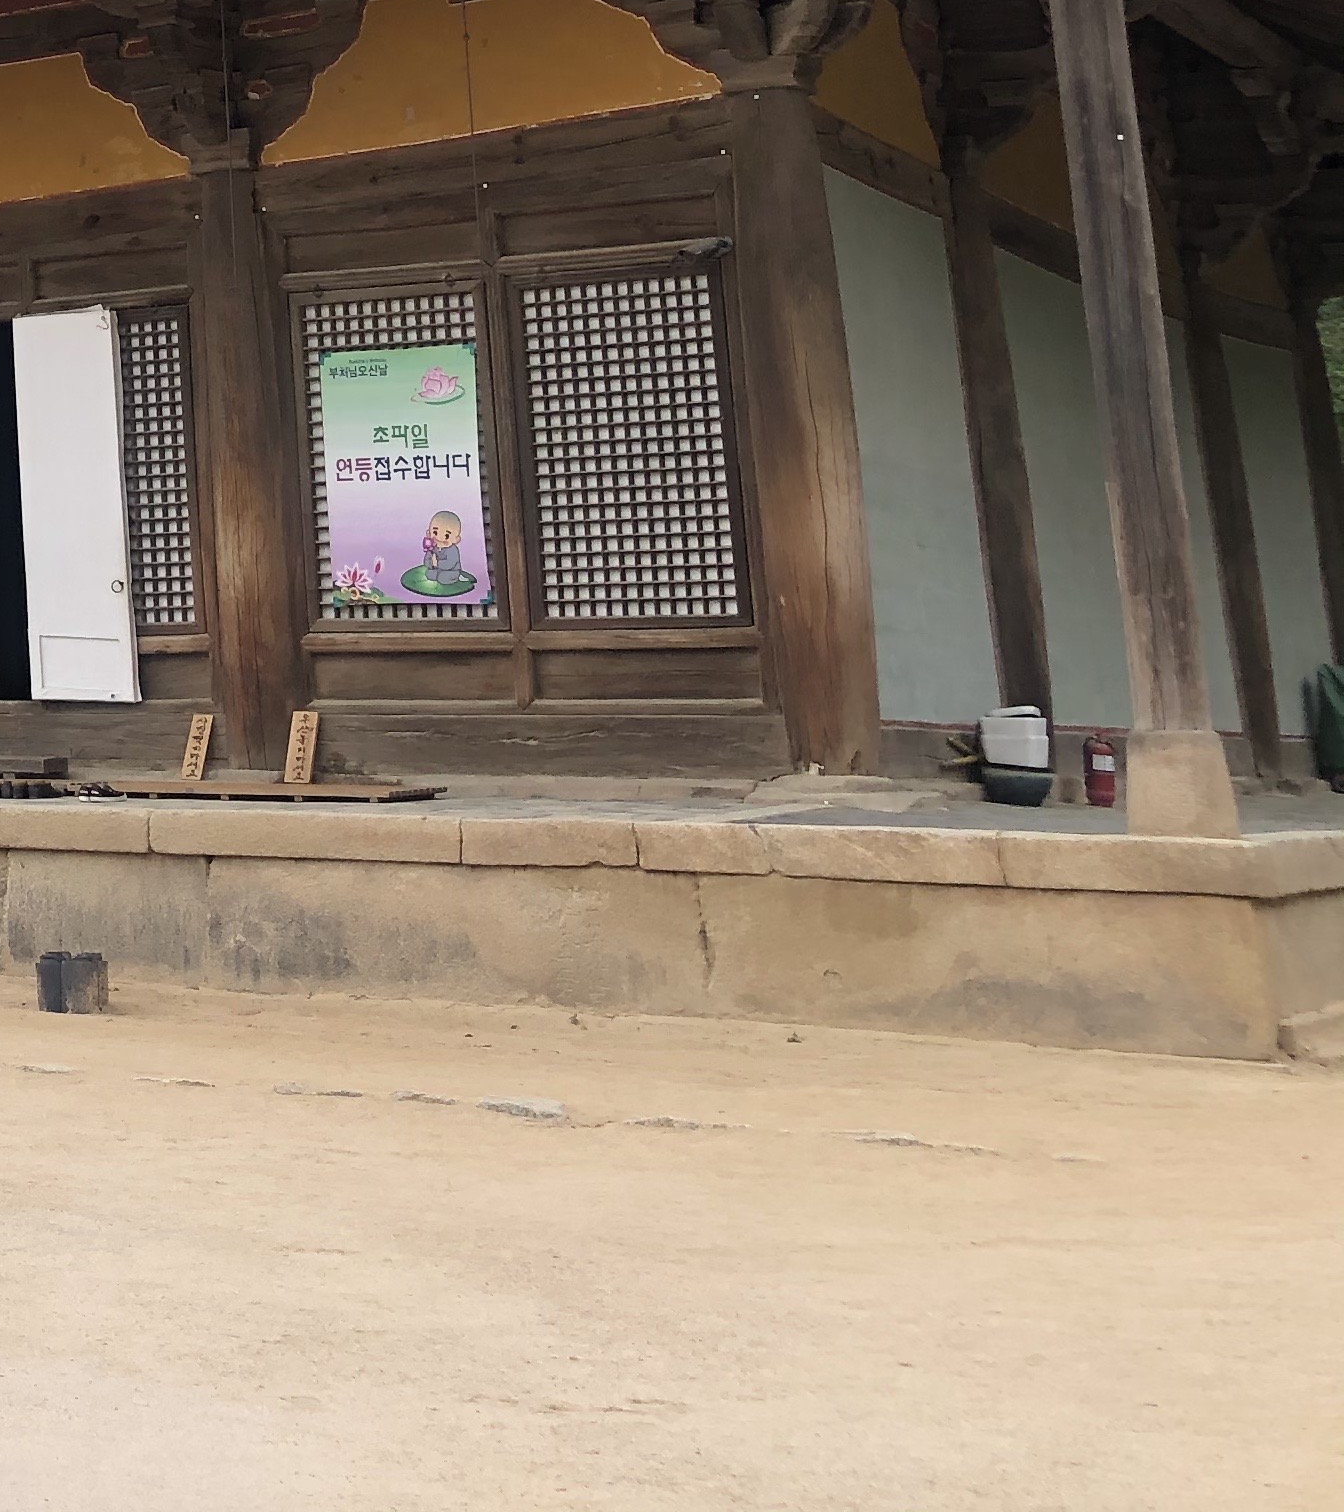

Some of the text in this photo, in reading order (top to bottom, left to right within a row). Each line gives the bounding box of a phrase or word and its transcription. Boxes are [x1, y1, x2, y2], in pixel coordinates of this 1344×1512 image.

[329, 364, 388, 379] 부처님오신날
[373, 423, 430, 449] 초파일
[336, 452, 472, 482] 연등접수합니다
